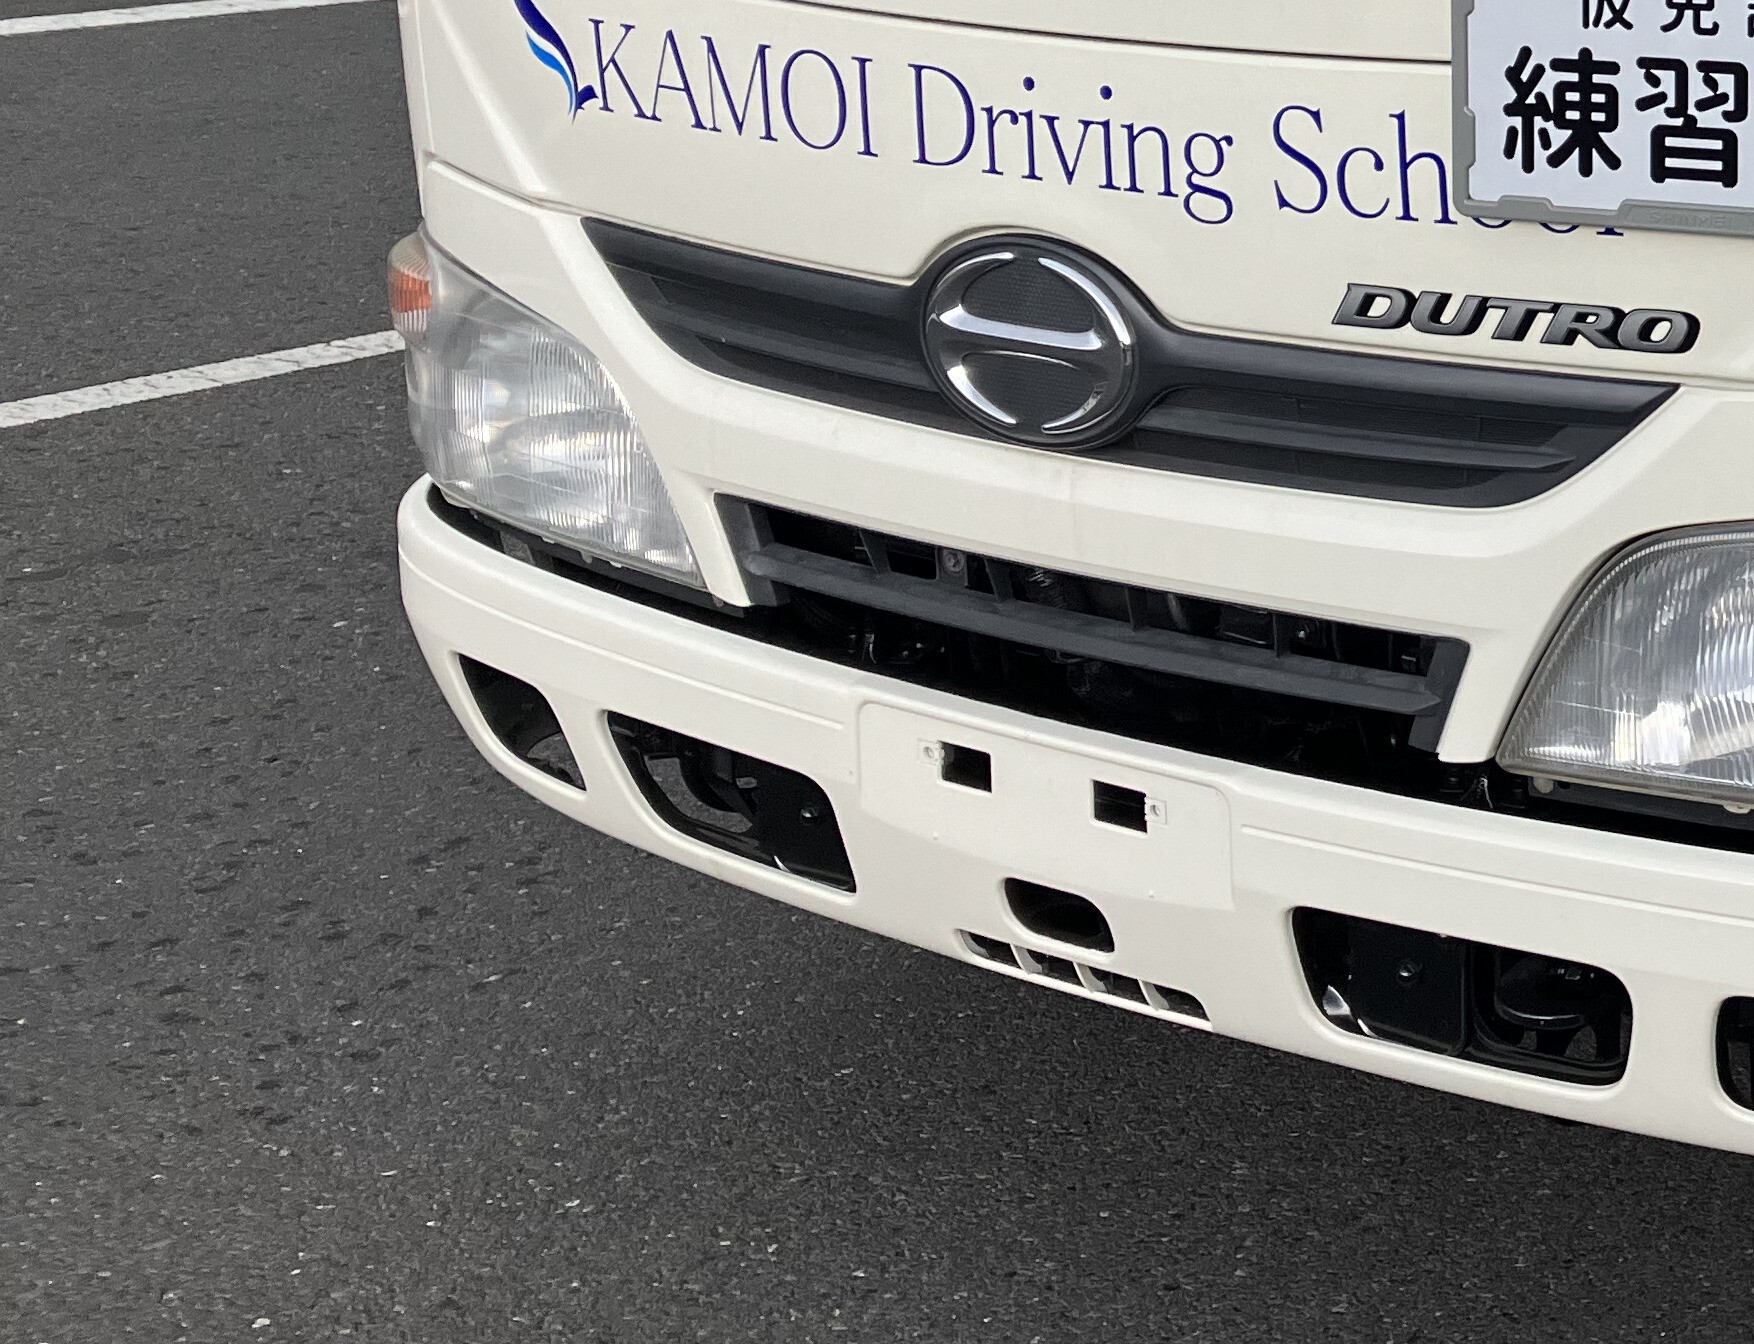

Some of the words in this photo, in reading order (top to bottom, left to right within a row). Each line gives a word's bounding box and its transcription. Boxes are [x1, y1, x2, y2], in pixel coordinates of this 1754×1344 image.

[588, 18, 878, 158] KAMOI
[907, 62, 1234, 225] Driving
[1273, 104, 1624, 237] Sch
[1331, 282, 1700, 354] DUTRO
